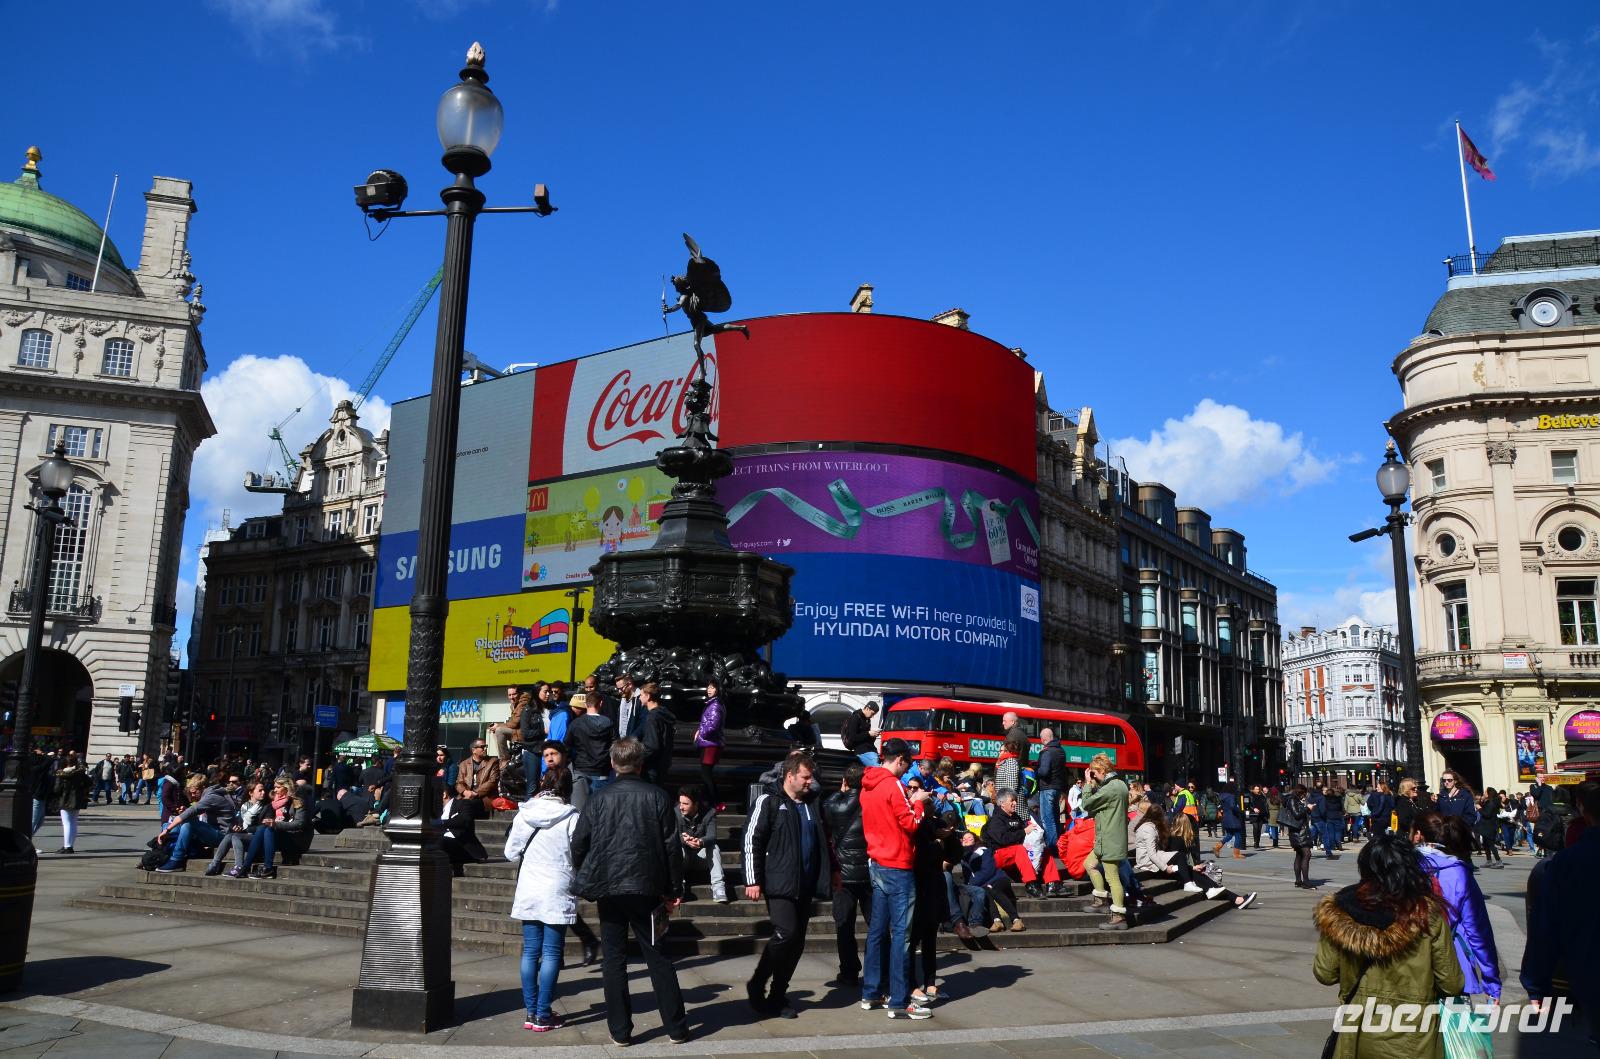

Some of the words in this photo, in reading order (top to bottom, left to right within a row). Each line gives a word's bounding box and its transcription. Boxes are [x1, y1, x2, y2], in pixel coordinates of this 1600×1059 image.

[1538, 414, 1599, 429] Believe
[755, 462, 789, 474] TRAINS
[792, 461, 821, 472] FROM
[823, 461, 881, 472] WATERLOO
[395, 543, 502, 580] SASUNG
[795, 602, 838, 620] Enjoy
[844, 603, 886, 618] FREE
[891, 604, 929, 621] Wi-Fi
[934, 608, 962, 624] here
[966, 613, 1007, 630] provided
[1009, 618, 1017, 636] by
[814, 622, 889, 638] HYUNDAI
[896, 625, 950, 642] MOTOR
[955, 629, 1009, 648] COMPANY
[475, 635, 527, 651] Piccadilly
[488, 649, 525, 662] Circus
[971, 739, 986, 750] GO
[987, 740, 1001, 751] HO
